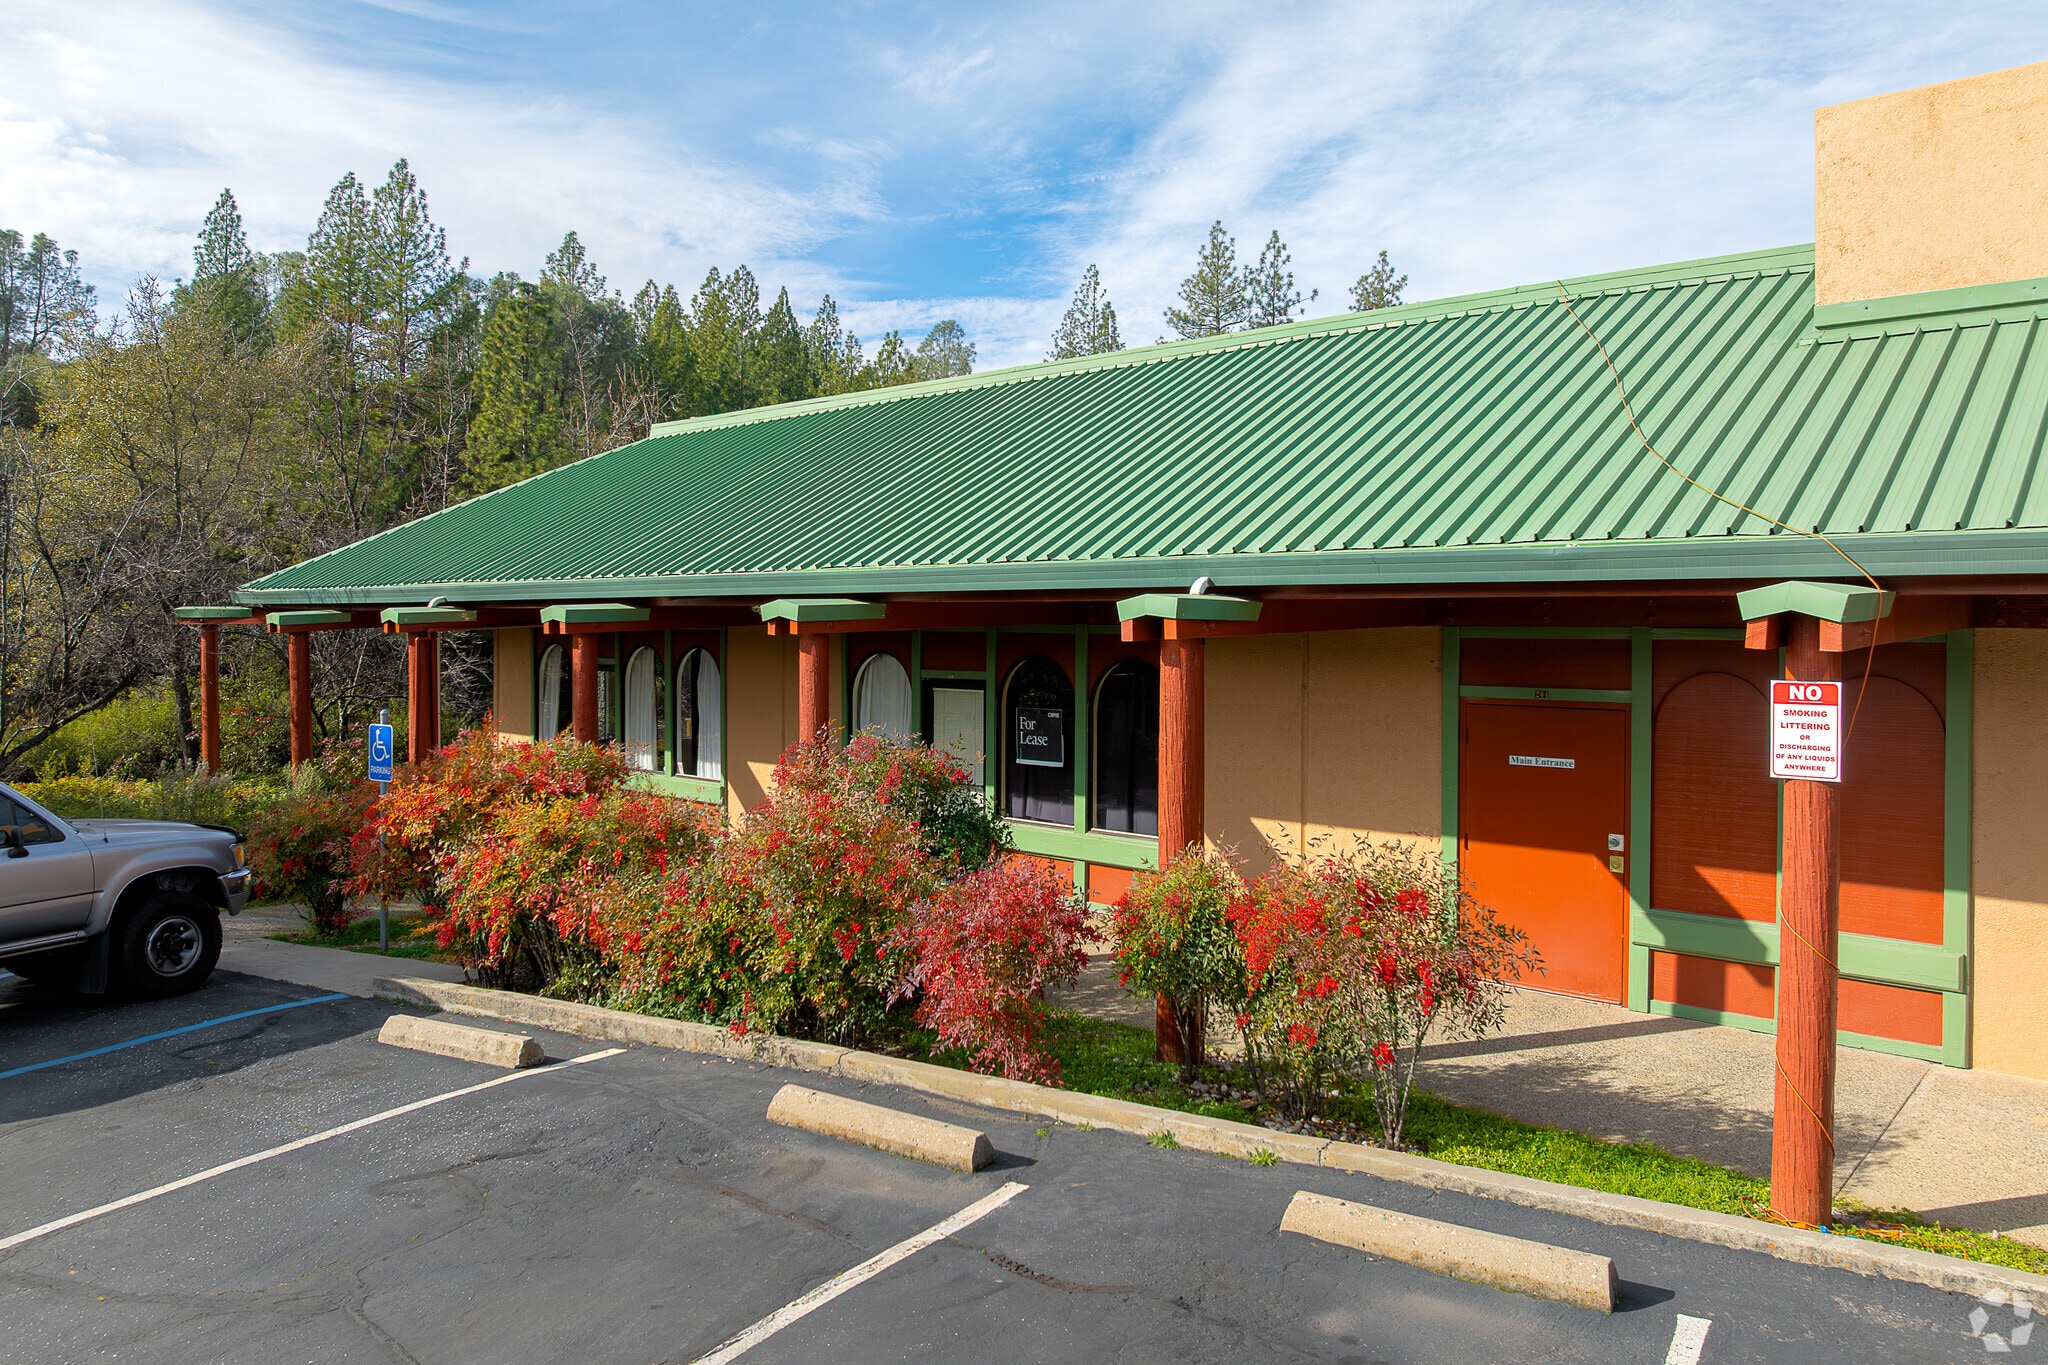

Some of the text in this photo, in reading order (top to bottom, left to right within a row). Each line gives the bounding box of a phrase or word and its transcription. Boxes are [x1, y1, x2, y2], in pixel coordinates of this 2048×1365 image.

[1789, 685, 1822, 701] NO
[1783, 709, 1828, 718] SMOKING
[1019, 716, 1036, 730] For
[1780, 722, 1830, 731] LITTERING
[1019, 731, 1048, 746] Lease
[1779, 743, 1831, 752] DISCHARGING
[1510, 756, 1574, 768] Main Entrance
[370, 765, 391, 775] PARKING
[1784, 764, 1826, 772] ANYWHERE
